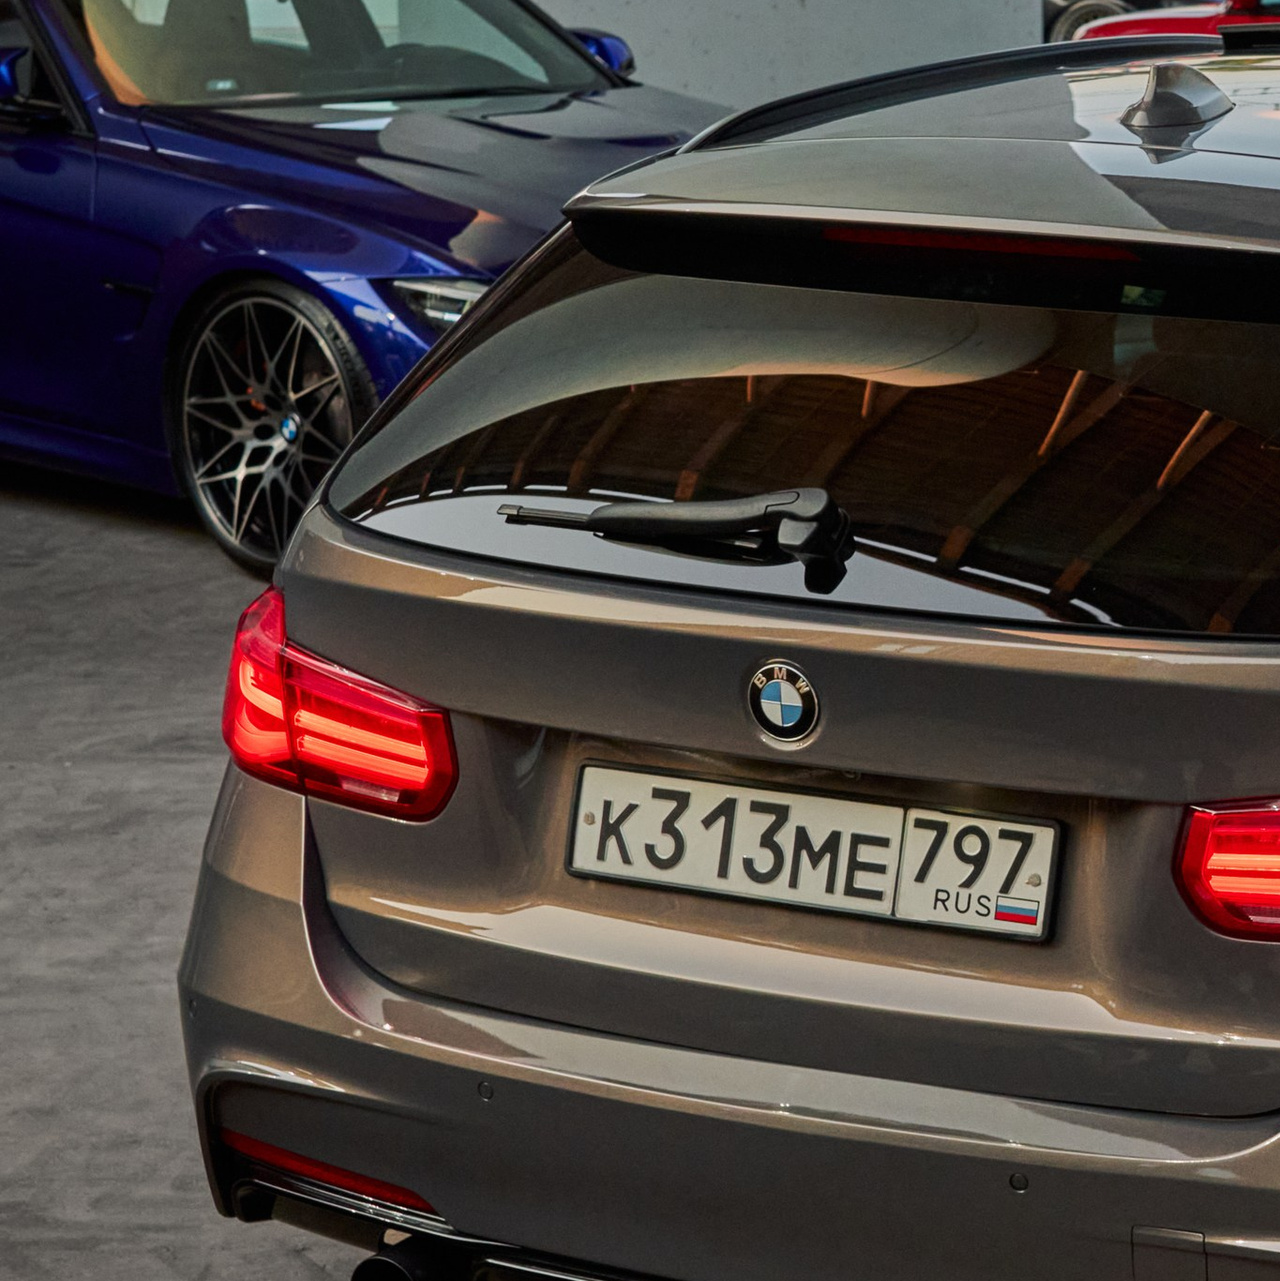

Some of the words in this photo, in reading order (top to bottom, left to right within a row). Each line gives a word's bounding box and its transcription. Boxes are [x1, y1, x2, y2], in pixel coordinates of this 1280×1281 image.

[753, 666, 810, 694] BMW
[597, 787, 890, 901] К313МЕ
[913, 818, 1034, 894] 797
[934, 888, 991, 918] RUS
